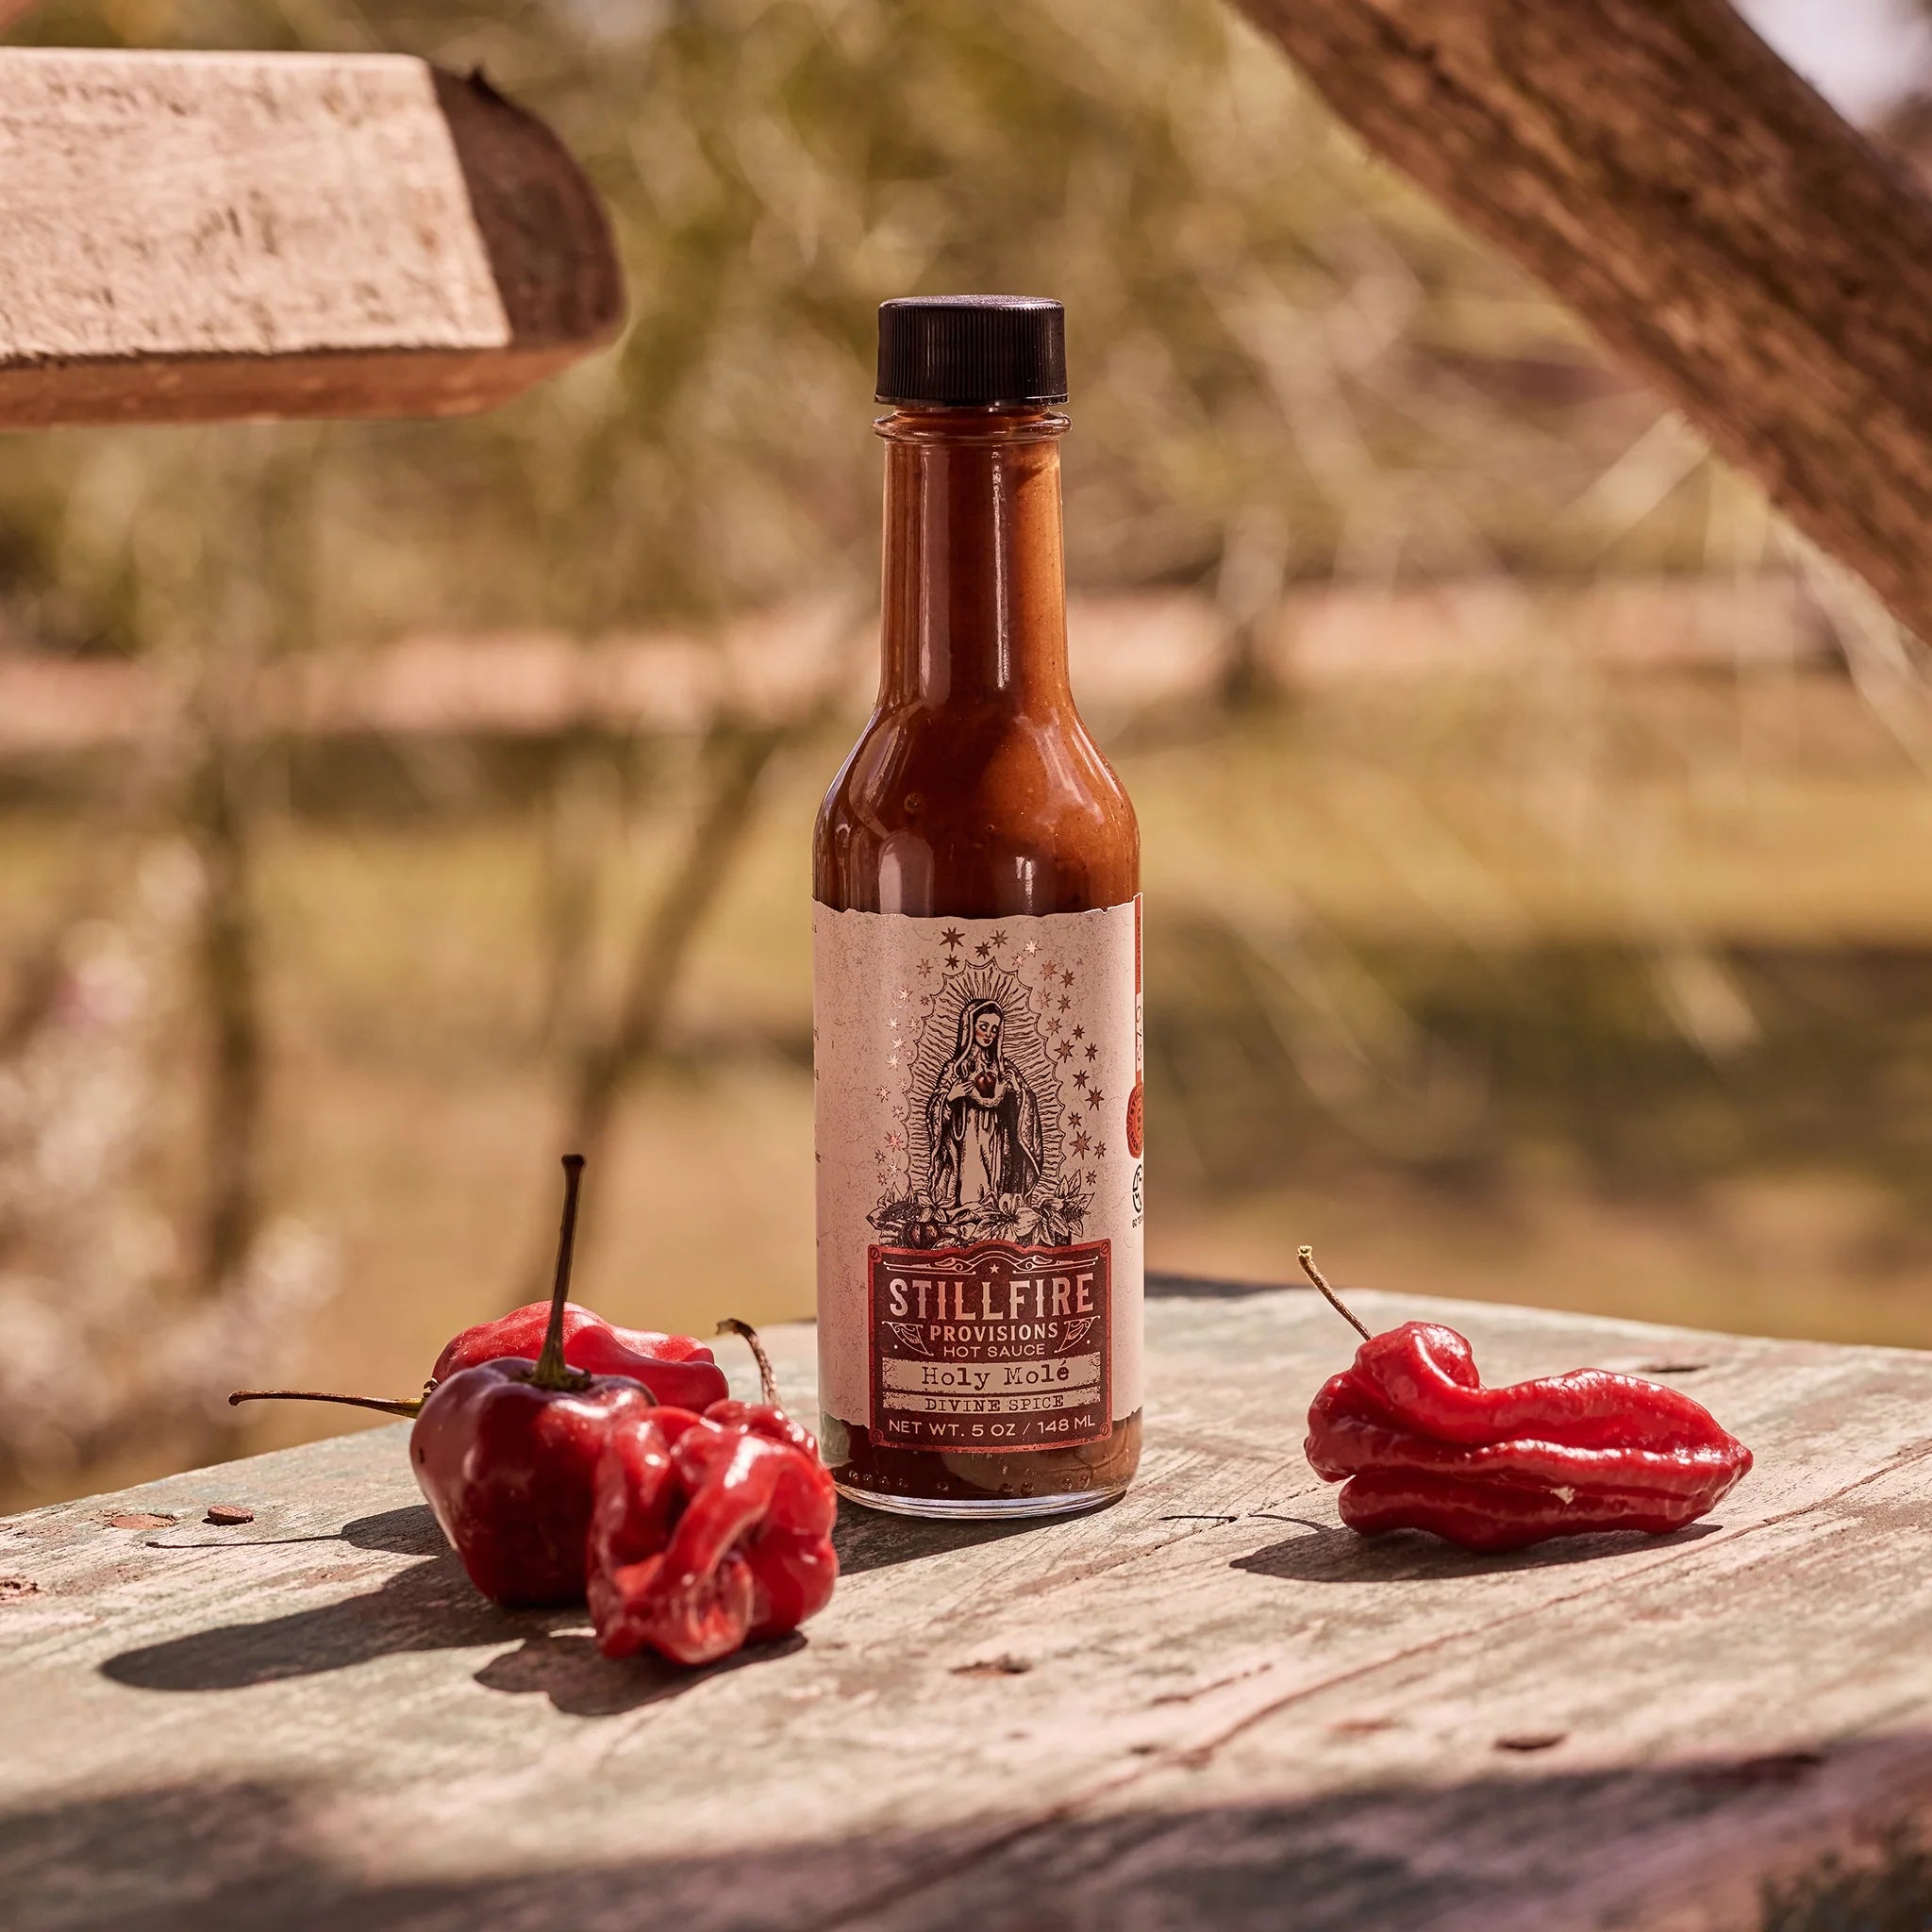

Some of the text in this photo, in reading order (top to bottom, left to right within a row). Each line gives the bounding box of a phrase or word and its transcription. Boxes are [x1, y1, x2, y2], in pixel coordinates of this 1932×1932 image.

[889, 1273, 1094, 1321] STILLFIRE
[929, 1322, 1058, 1342] PROVISIONS
[943, 1343, 1045, 1357] HOT SAUCE
[922, 1358, 1070, 1389] Holy Molé
[924, 1395, 1064, 1412] DIVINE SPICE
[889, 1420, 922, 1435] NET
[929, 1424, 965, 1437] WT.
[972, 1424, 984, 1437] 5
[991, 1424, 1016, 1437] OZ
[1038, 1419, 1069, 1434] 148
[1074, 1415, 1095, 1430] ML
